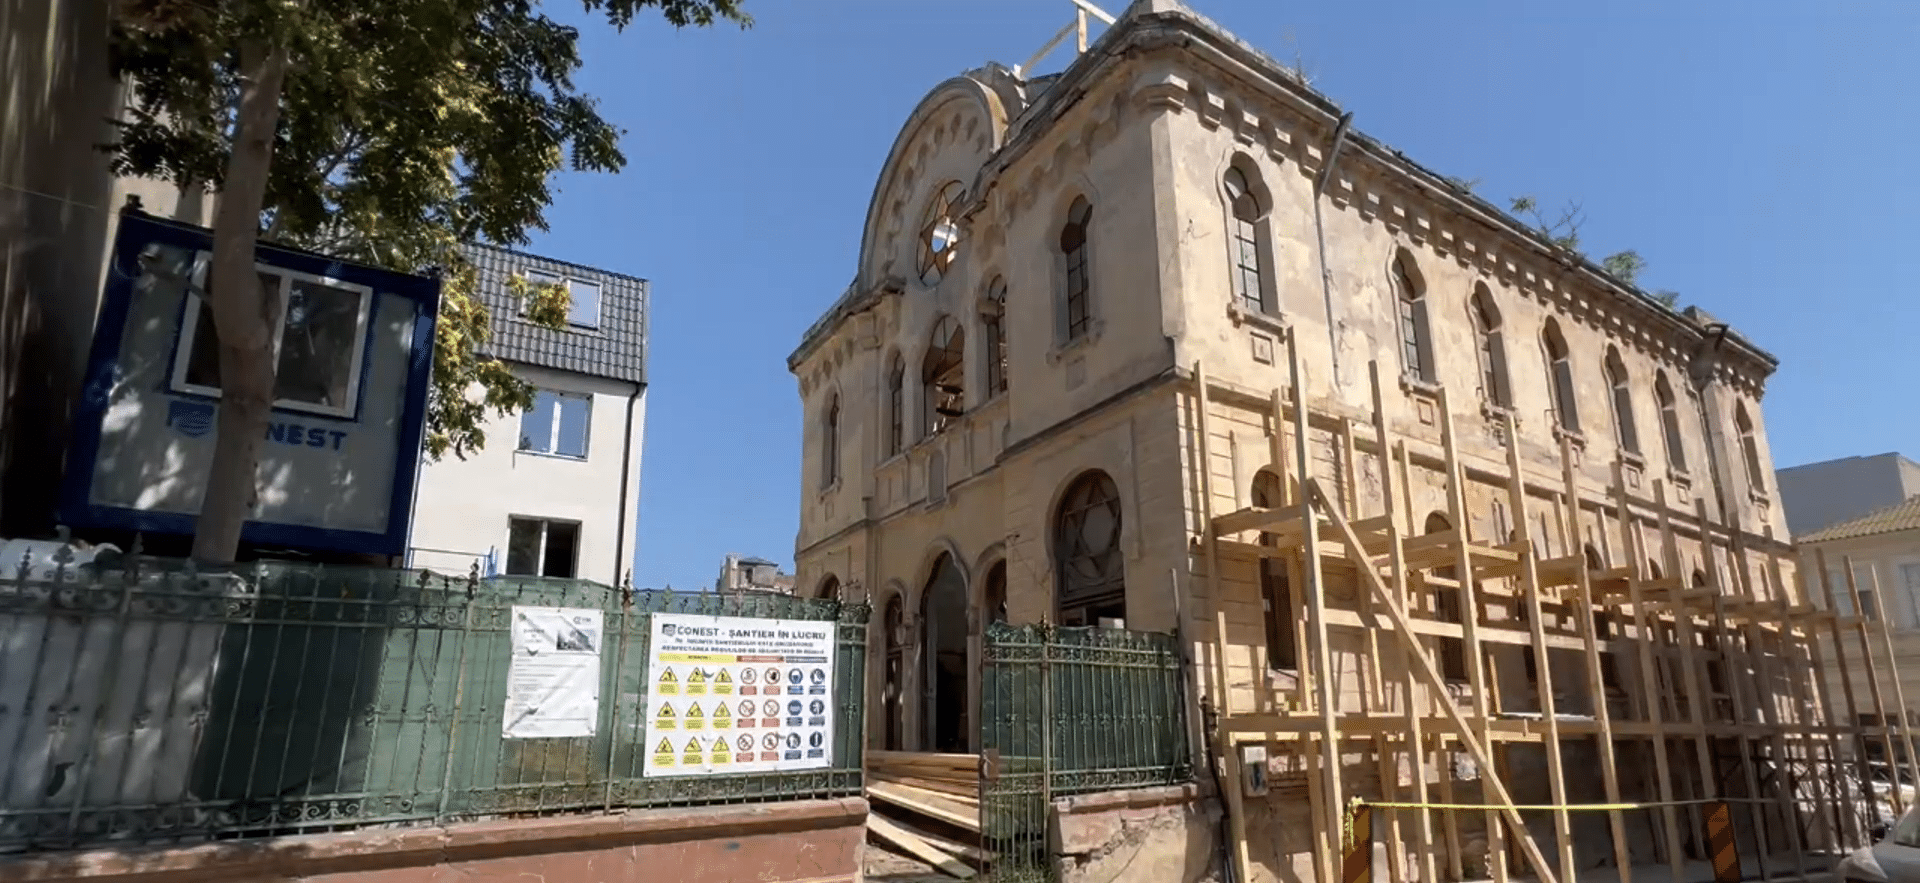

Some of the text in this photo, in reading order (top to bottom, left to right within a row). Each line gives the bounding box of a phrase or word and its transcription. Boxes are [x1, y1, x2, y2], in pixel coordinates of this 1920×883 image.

[265, 422, 347, 451] NEST
[677, 626, 719, 636] CONEST
[792, 631, 826, 640] LUCRU
